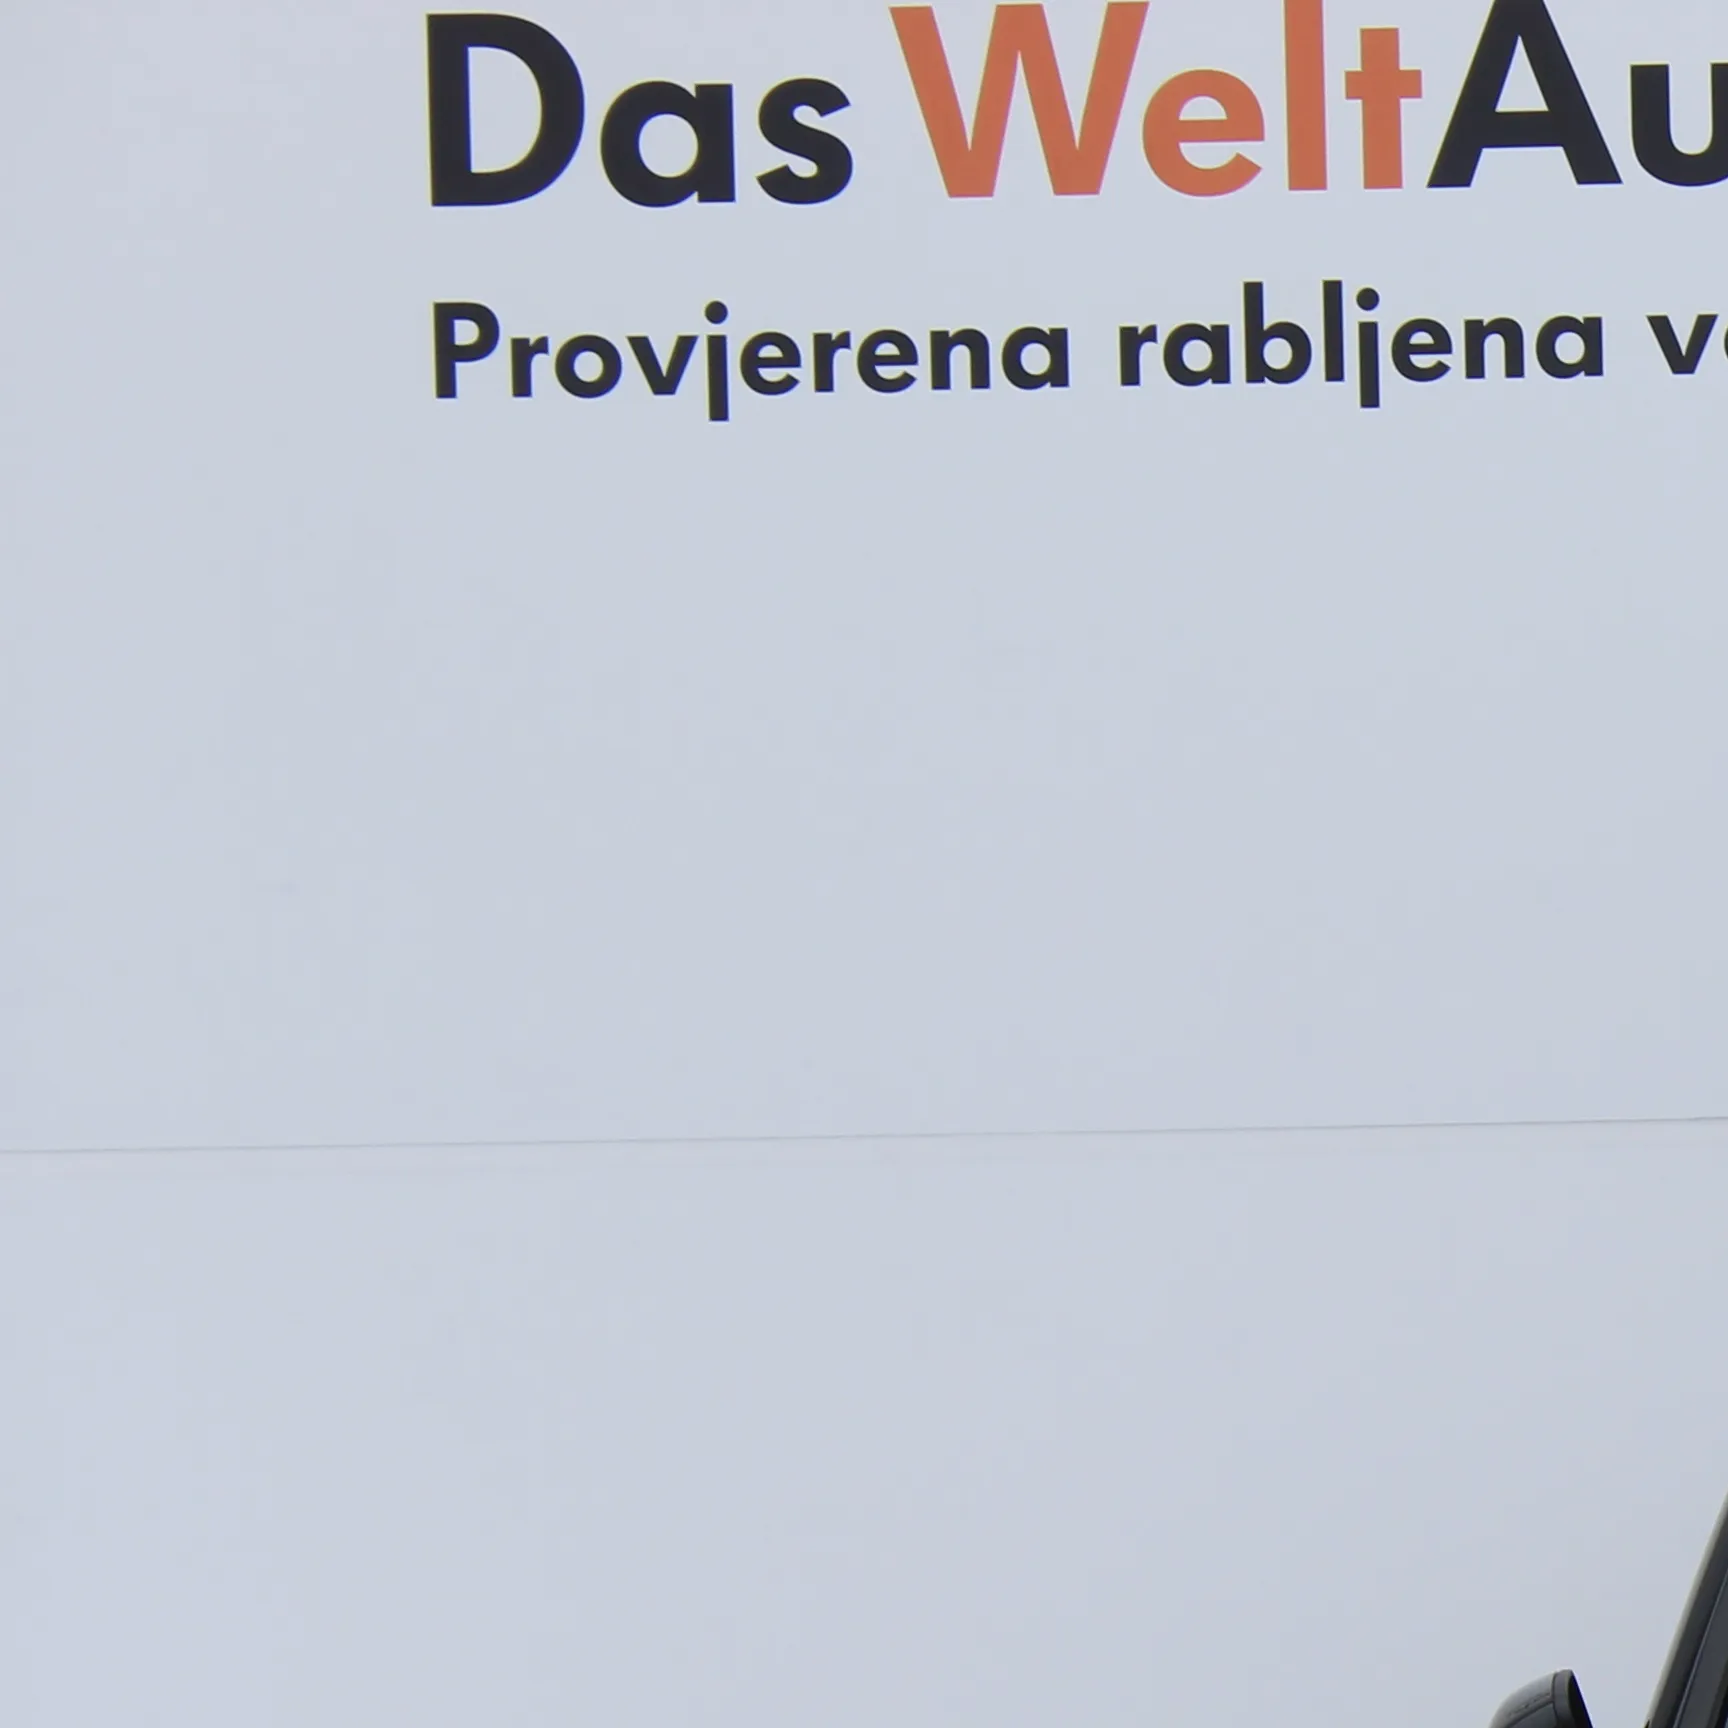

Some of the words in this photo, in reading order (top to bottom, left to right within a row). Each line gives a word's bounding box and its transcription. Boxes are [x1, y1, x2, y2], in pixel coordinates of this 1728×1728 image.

[426, 13, 853, 208] Das
[432, 300, 1069, 422] Provjerena
[1118, 280, 1603, 409] rabljena
